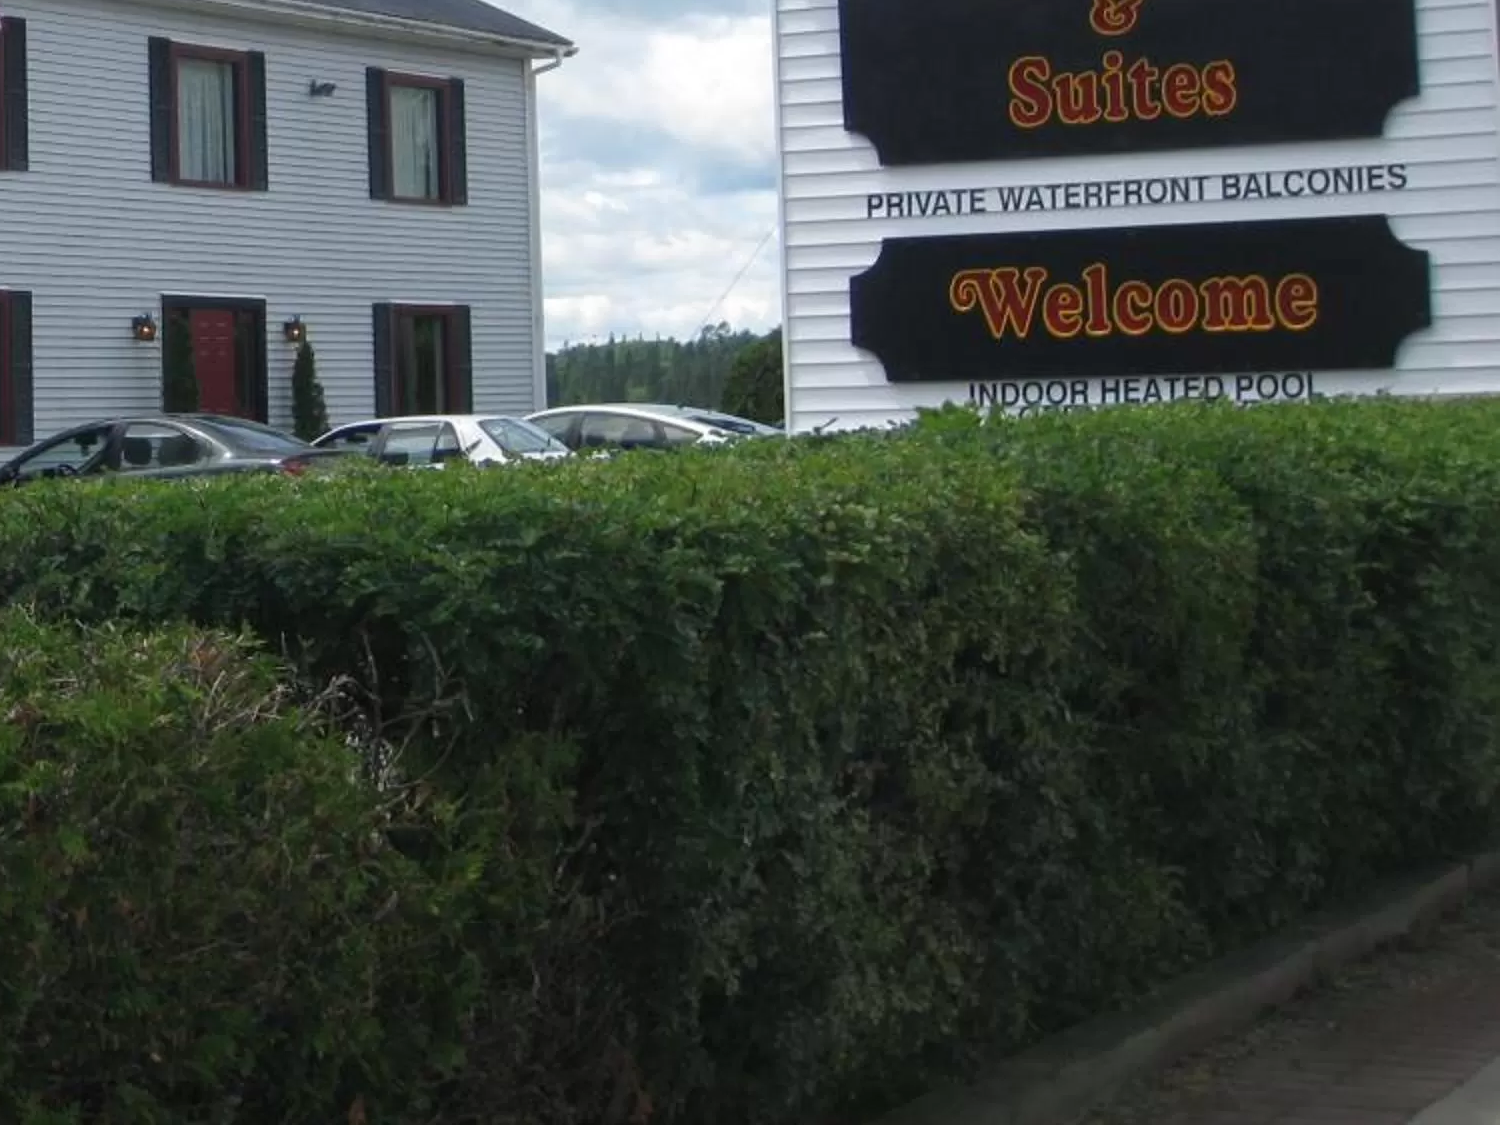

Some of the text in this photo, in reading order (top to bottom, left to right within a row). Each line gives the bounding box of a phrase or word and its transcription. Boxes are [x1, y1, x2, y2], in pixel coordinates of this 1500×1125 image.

[1008, 50, 1238, 128] Suites
[866, 163, 1408, 220] PRIVATE WATERFRONT BALCONIES
[949, 261, 1319, 340] Welcome
[968, 370, 1318, 407] INDOOR HEATED POOL
